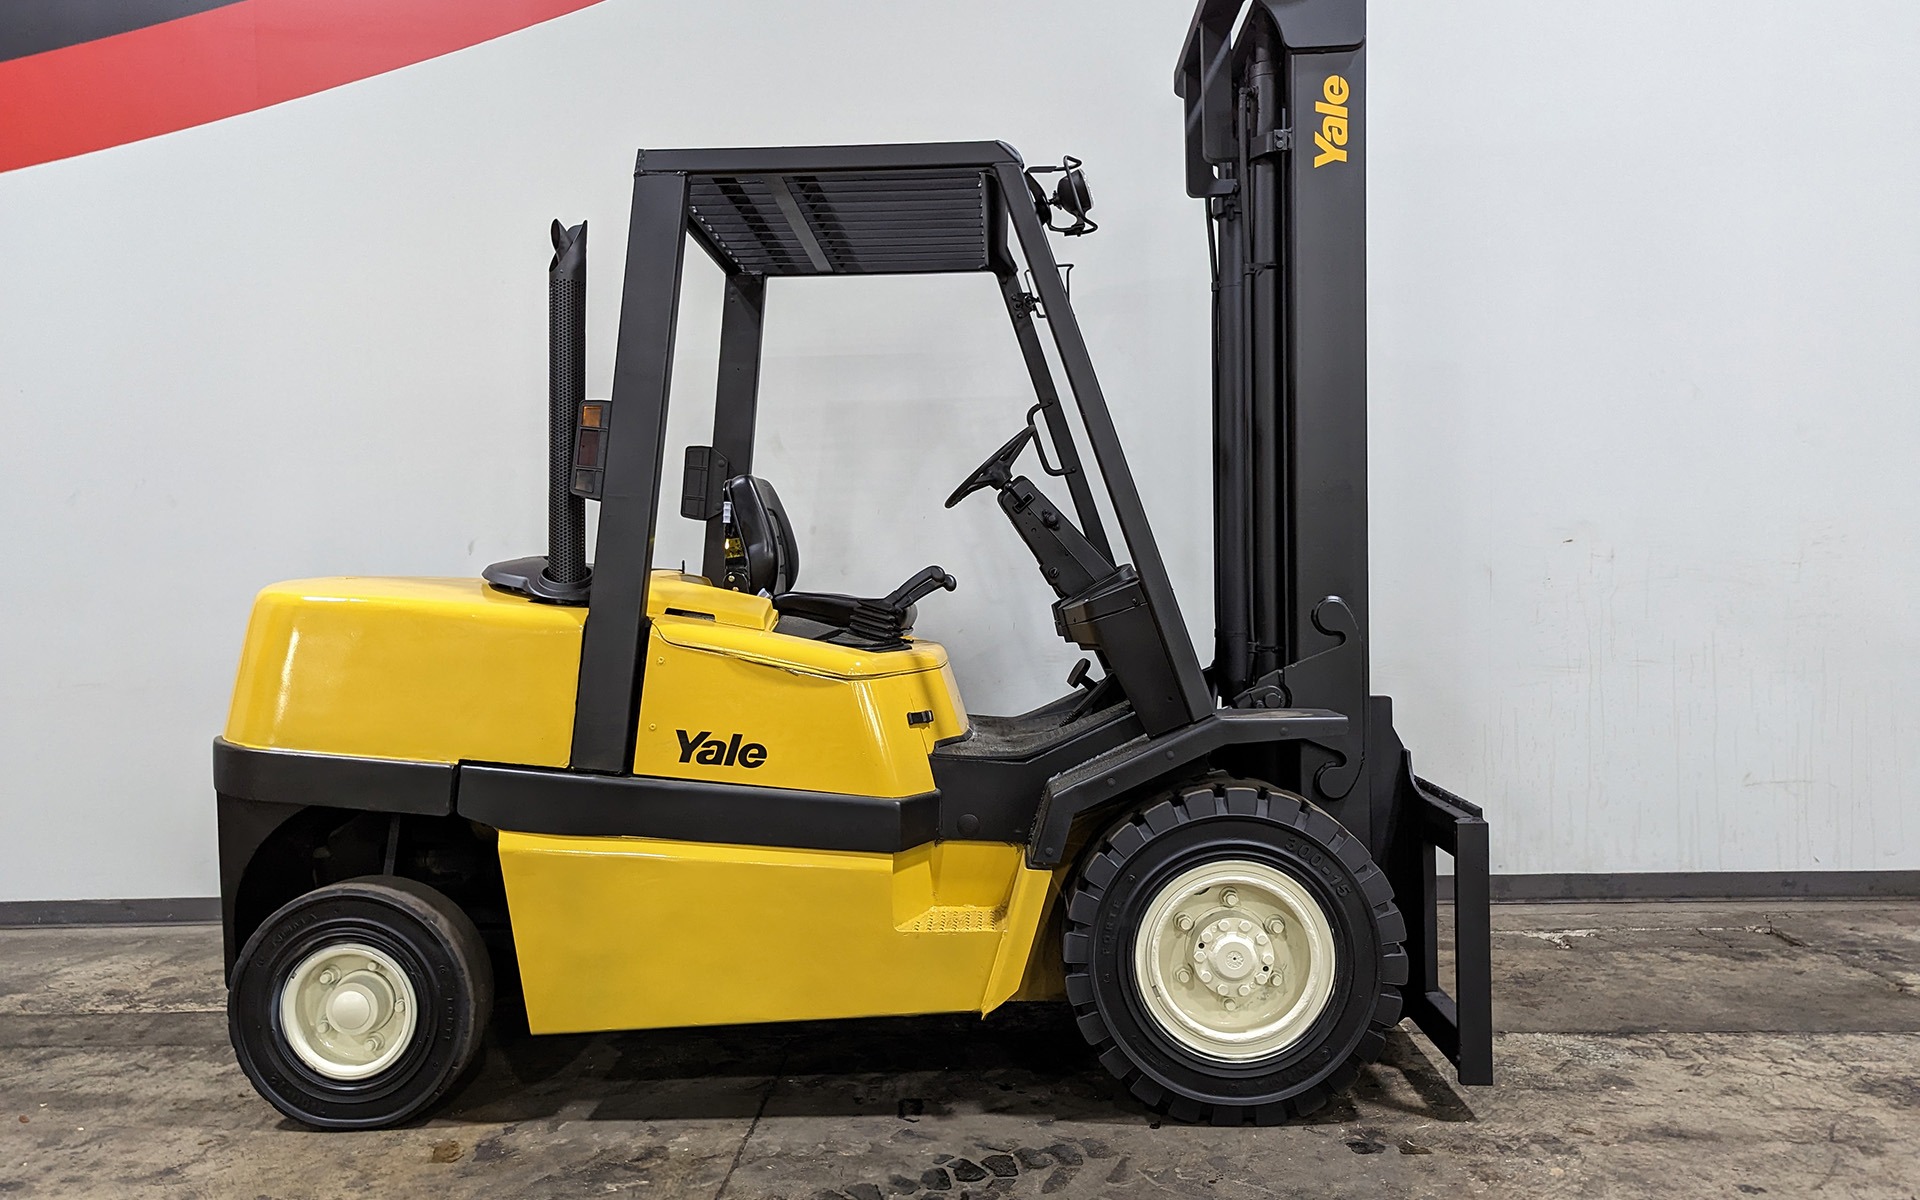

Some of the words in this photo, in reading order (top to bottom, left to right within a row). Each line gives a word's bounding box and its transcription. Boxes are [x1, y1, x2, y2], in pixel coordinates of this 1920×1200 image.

[1313, 75, 1349, 169] Yale
[676, 729, 768, 769] Yale
[1285, 837, 1352, 897] 300-15
[1102, 900, 1122, 955] FORTE
